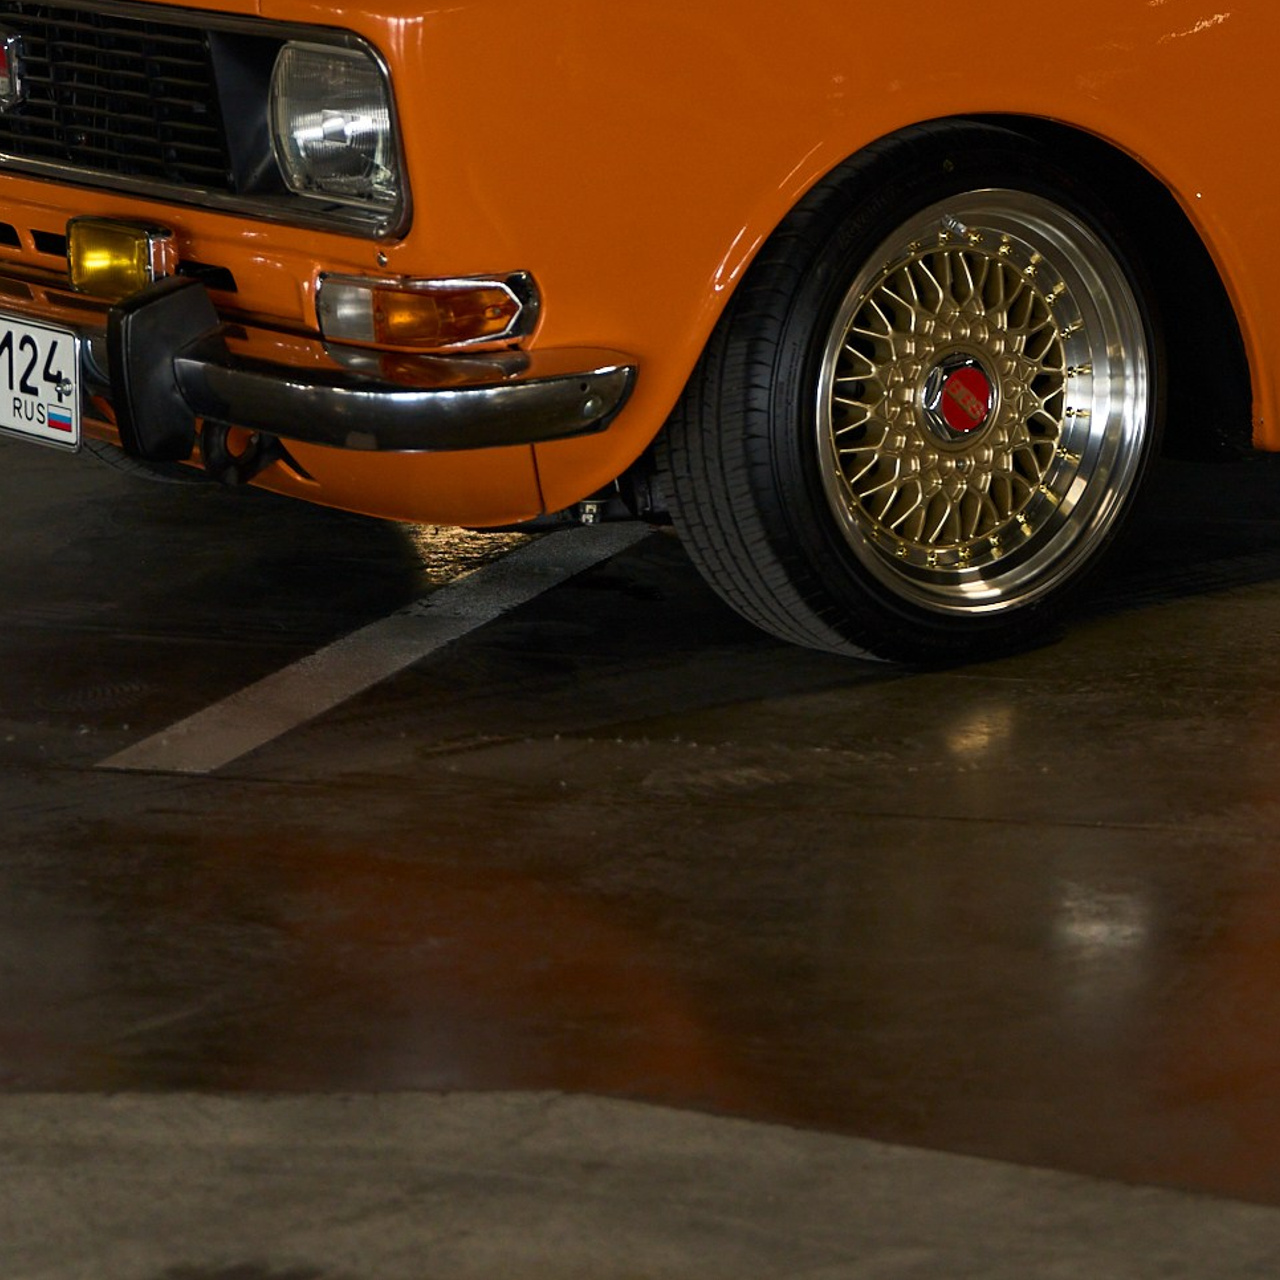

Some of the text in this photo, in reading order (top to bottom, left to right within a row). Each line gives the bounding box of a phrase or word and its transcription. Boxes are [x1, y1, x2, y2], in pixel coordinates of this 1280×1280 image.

[0, 330, 63, 403] 124
[13, 397, 46, 424] RUS
[945, 379, 985, 421] BBS
